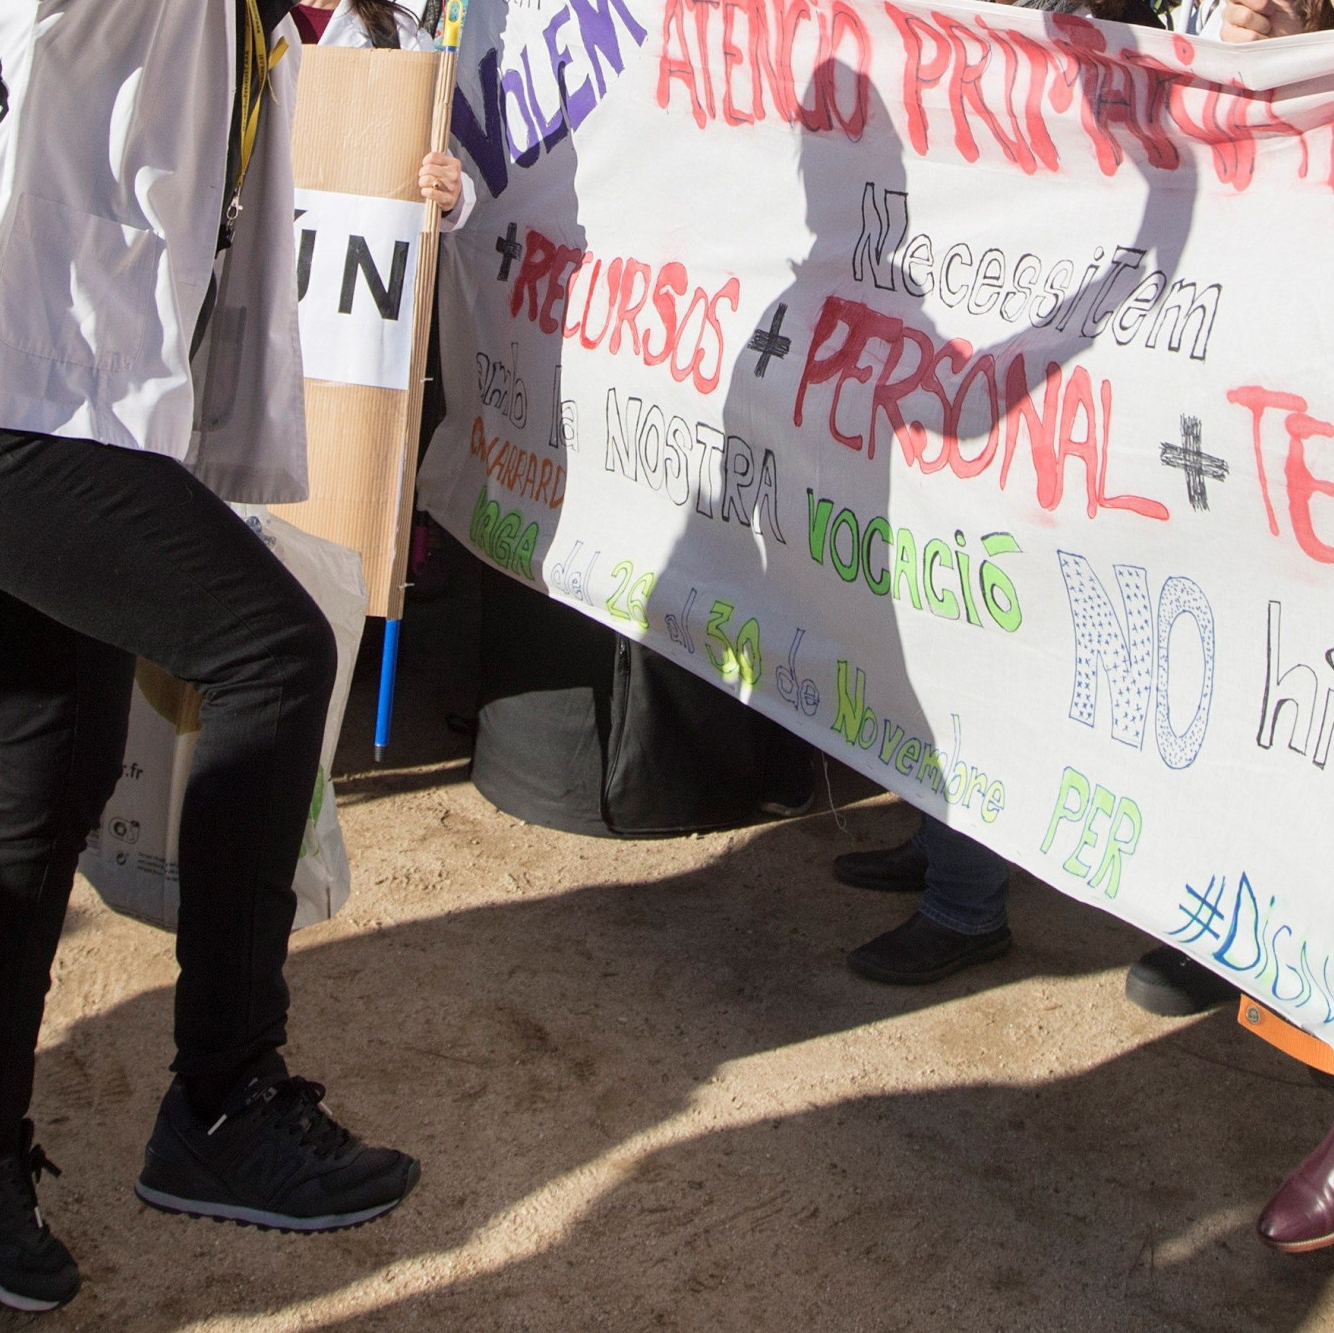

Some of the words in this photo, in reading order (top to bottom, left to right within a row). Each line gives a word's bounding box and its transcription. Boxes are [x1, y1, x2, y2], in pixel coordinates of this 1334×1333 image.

[604, 387, 787, 545] NOSTRA
[1056, 550, 1216, 770] NO
[604, 559, 654, 630] 26
[830, 659, 1007, 824] Novembre
[1040, 765, 1144, 900] PER
